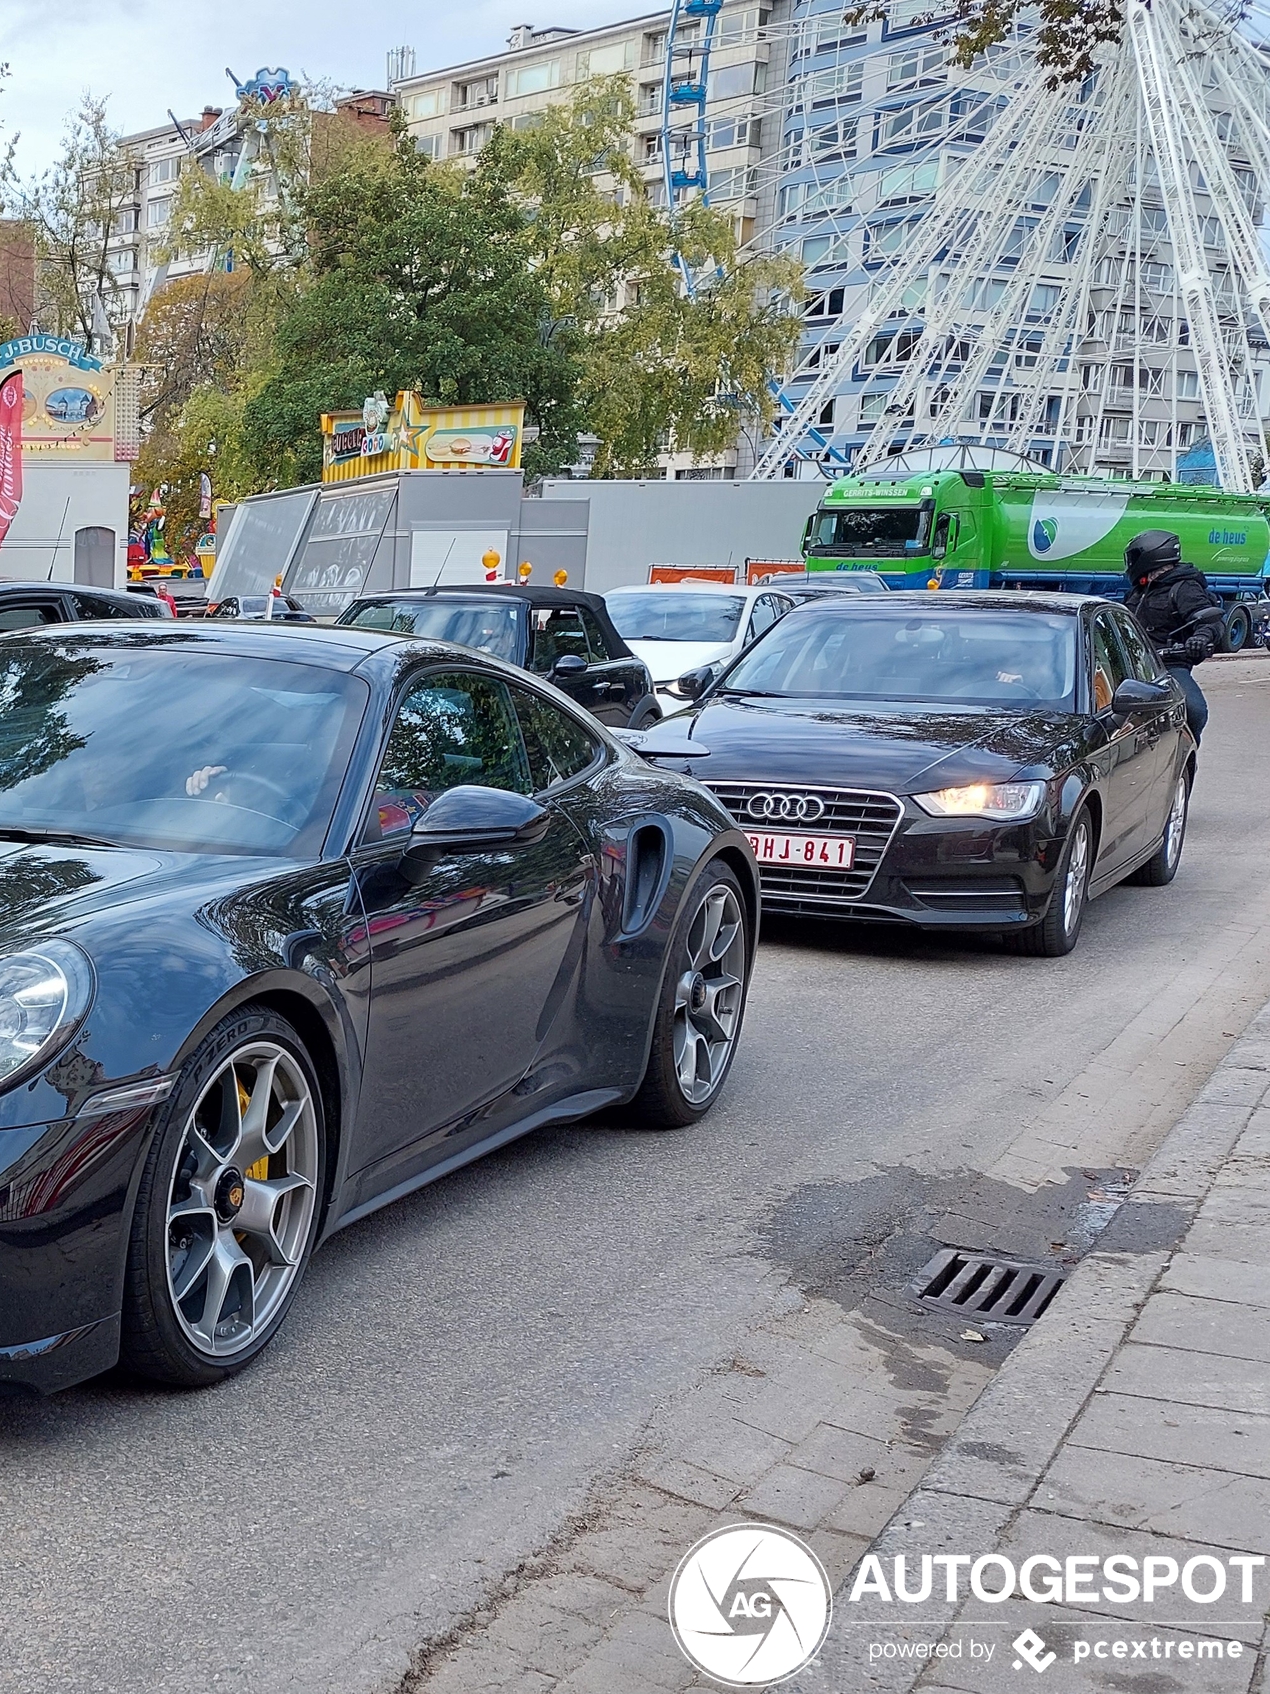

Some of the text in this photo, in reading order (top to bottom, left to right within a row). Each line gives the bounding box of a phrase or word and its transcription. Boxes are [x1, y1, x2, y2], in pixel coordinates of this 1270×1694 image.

[843, 488, 908, 497] GERRITS-WINSSEN
[1209, 528, 1246, 544] de heus
[836, 562, 849, 571] de
[193, 1020, 248, 1085] P ZERO
